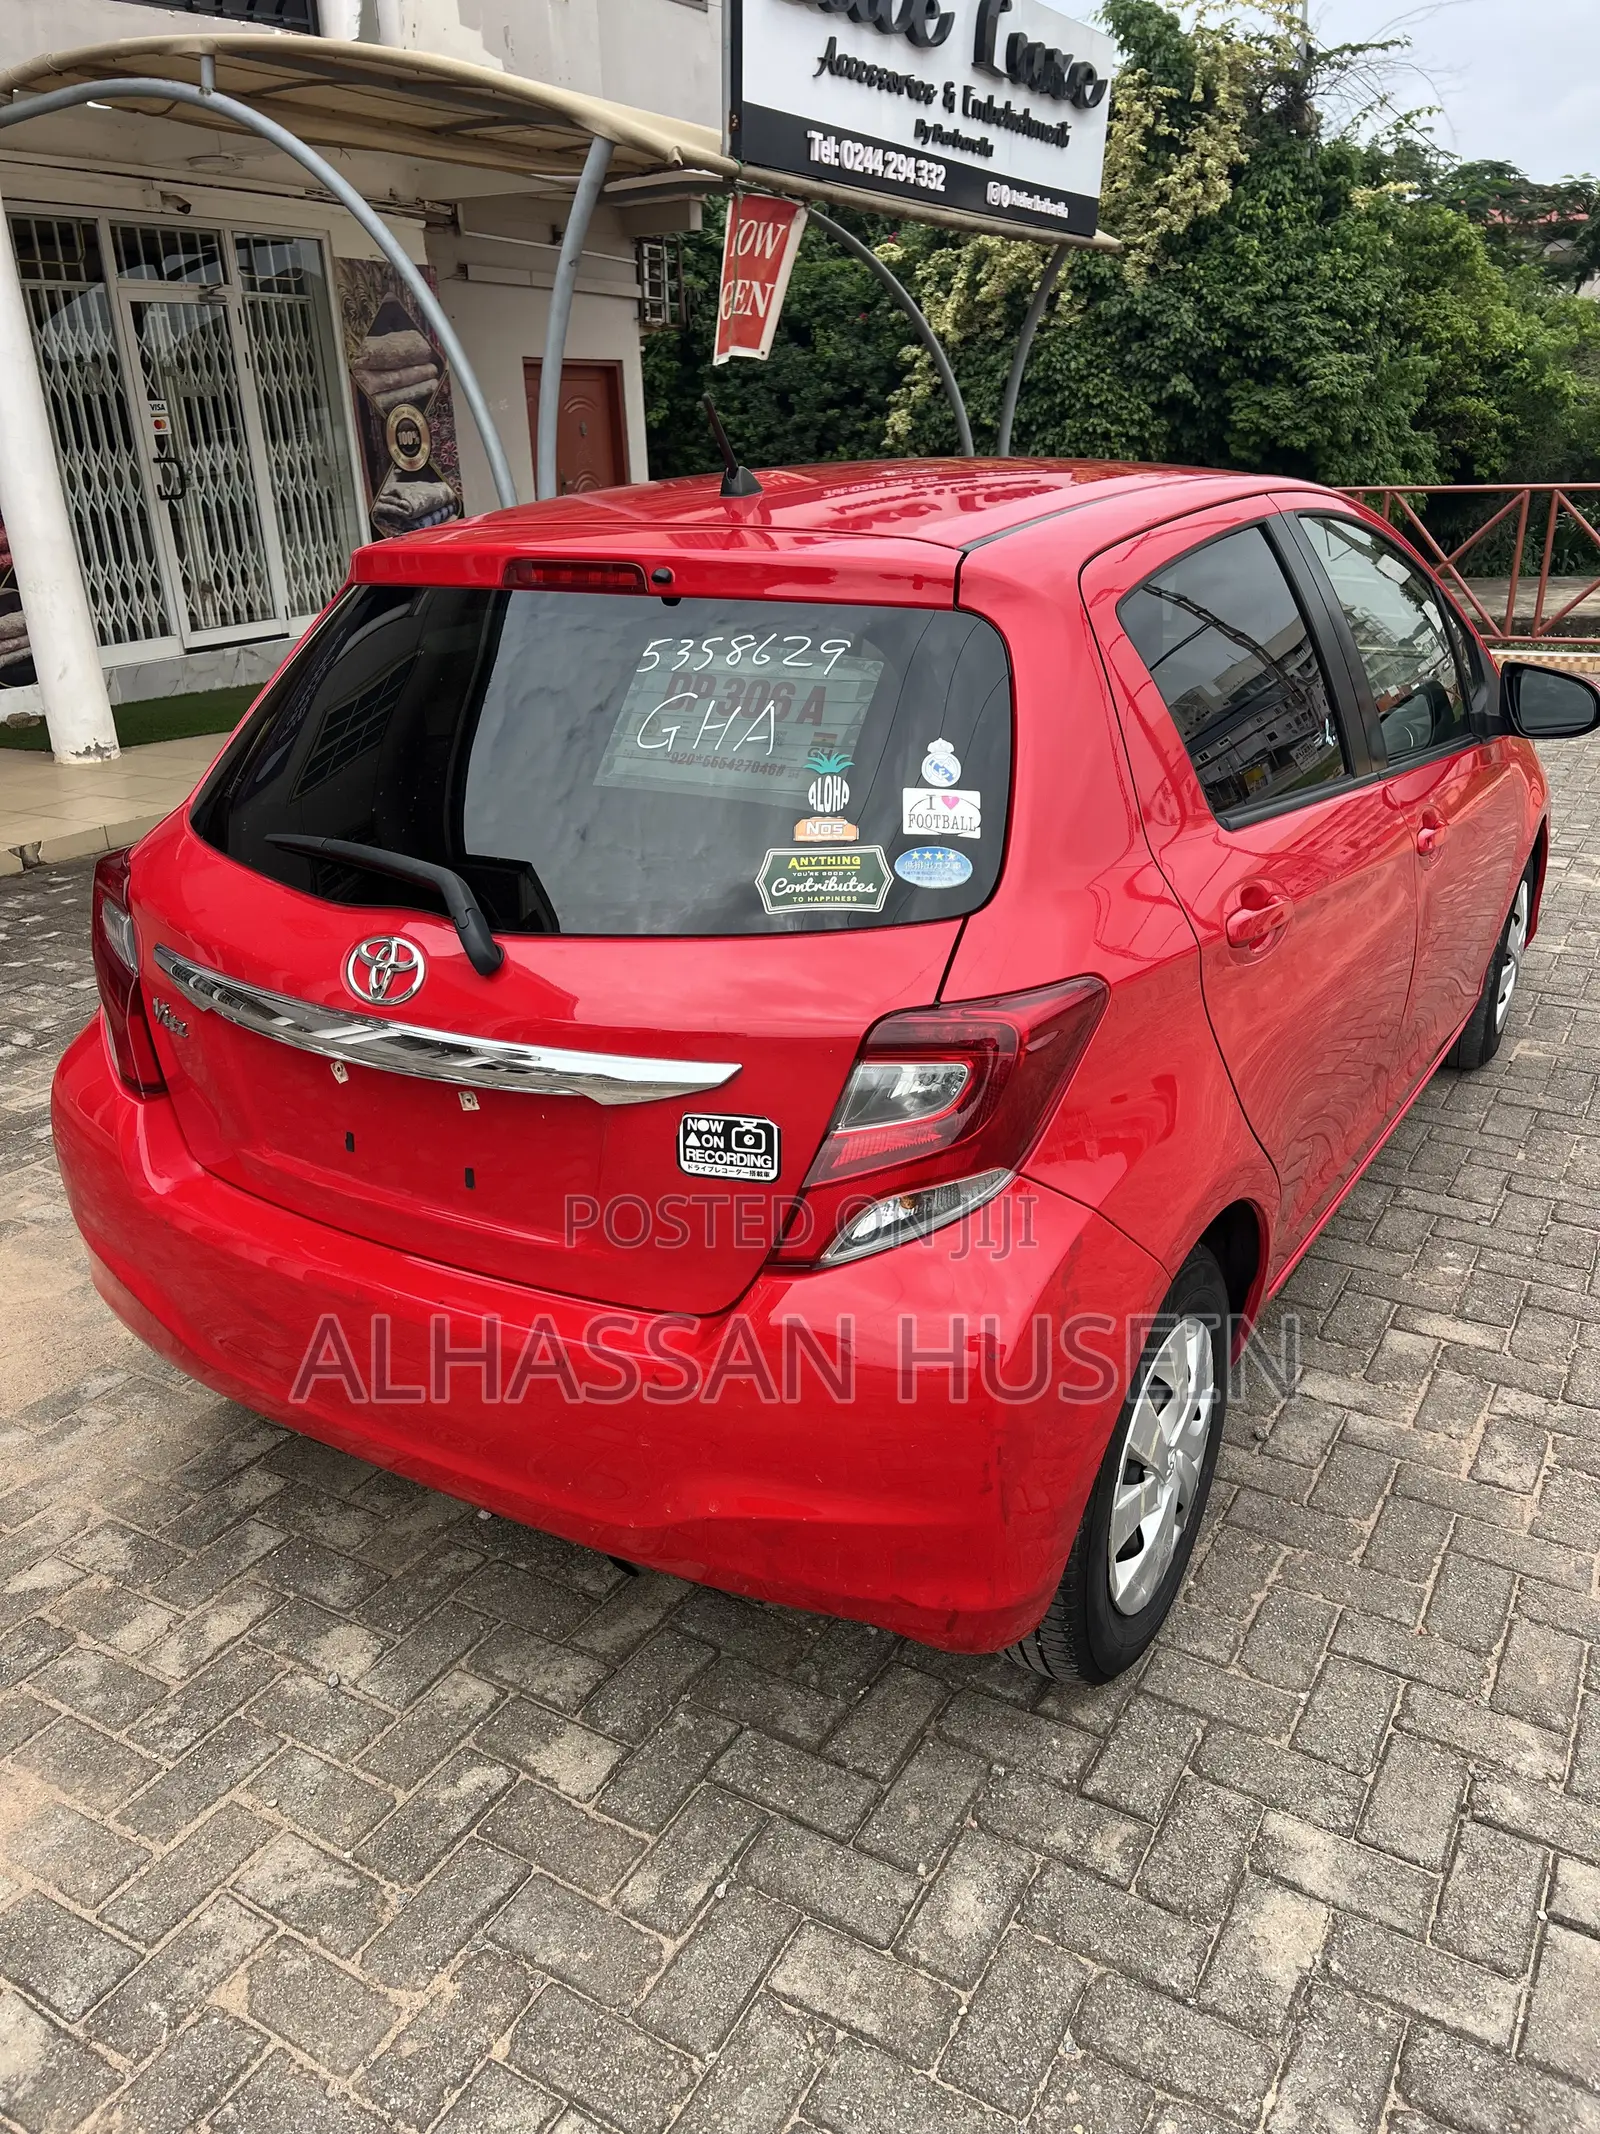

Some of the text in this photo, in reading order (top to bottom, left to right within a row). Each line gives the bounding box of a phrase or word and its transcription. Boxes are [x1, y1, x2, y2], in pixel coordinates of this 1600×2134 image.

[942, 81, 957, 113] &
[914, 119, 933, 145] By
[807, 130, 947, 192] Tel: 0244 294 332
[150, 403, 166, 411] VISA
[397, 431, 420, 445] 100%
[636, 632, 852, 675] 5358629
[663, 672, 827, 726] DP 306 A
[636, 692, 775, 755] GHA
[808, 775, 850, 813] ALOHA
[926, 794, 936, 810] I
[806, 821, 844, 836] NOS
[907, 813, 976, 832] FOOTBALL
[788, 856, 861, 869] ANYTHING
[771, 876, 877, 897] Contributes
[687, 1118, 724, 1133] NOW
[701, 1134, 724, 1148] ON
[686, 1148, 772, 1168] RECORDING
